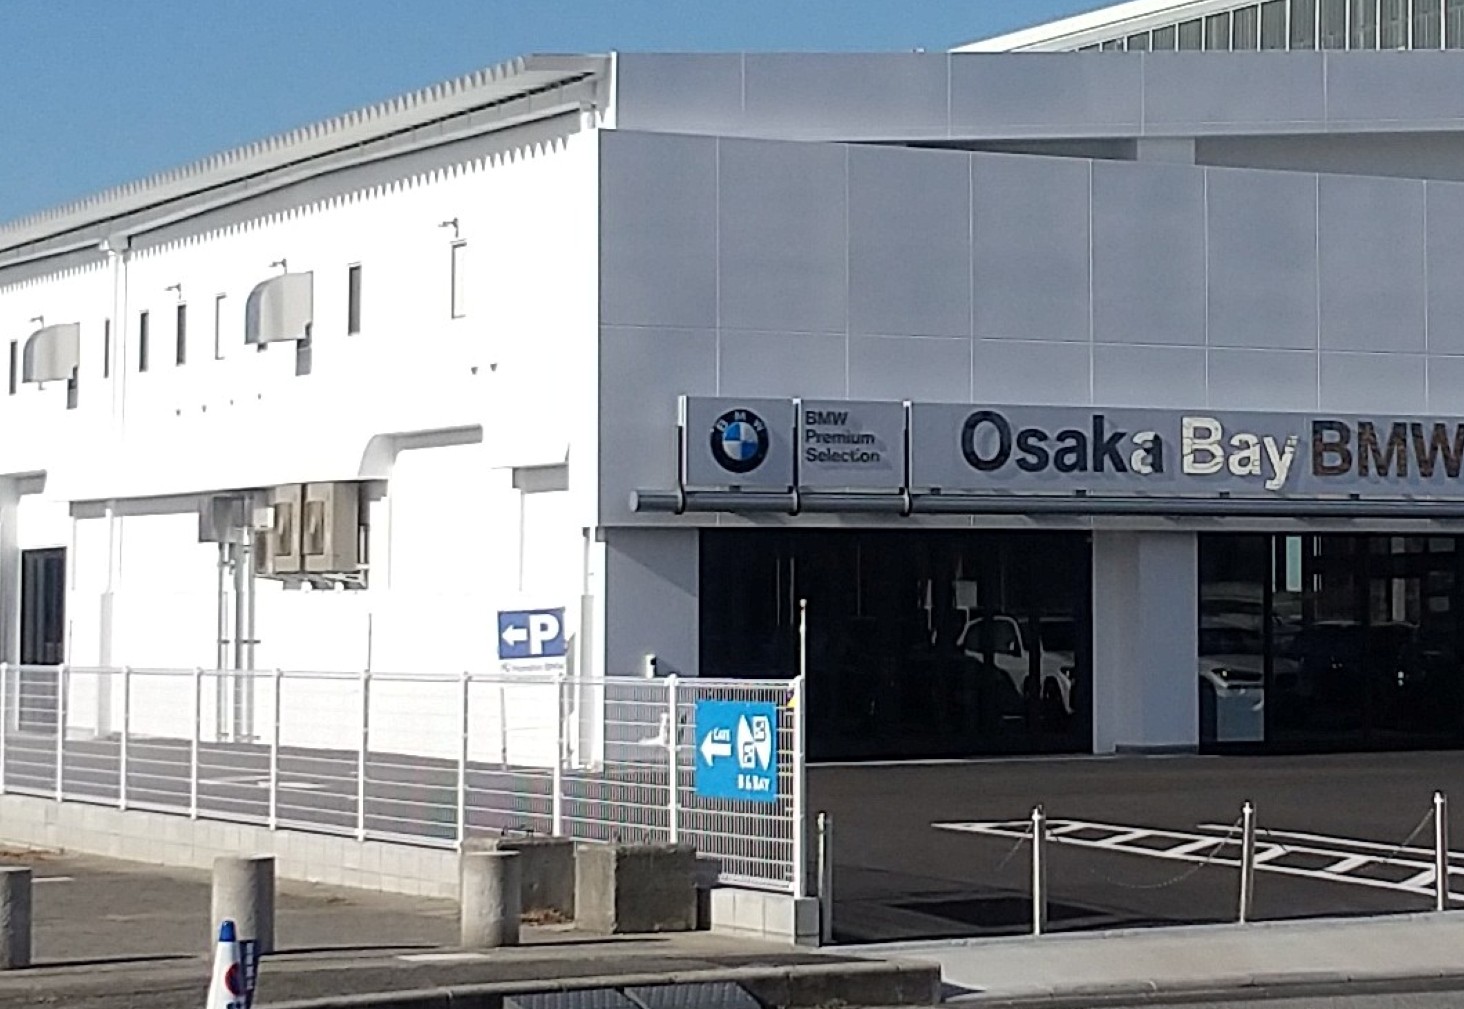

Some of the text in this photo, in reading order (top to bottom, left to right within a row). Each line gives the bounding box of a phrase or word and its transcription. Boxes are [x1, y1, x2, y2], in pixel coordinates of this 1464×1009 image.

[805, 411, 848, 426] BMW
[805, 429, 876, 445] Premium
[805, 448, 881, 463] Selection
[961, 410, 1164, 473] Osaka
[1181, 416, 1298, 490] Bay
[529, 613, 559, 655] P
